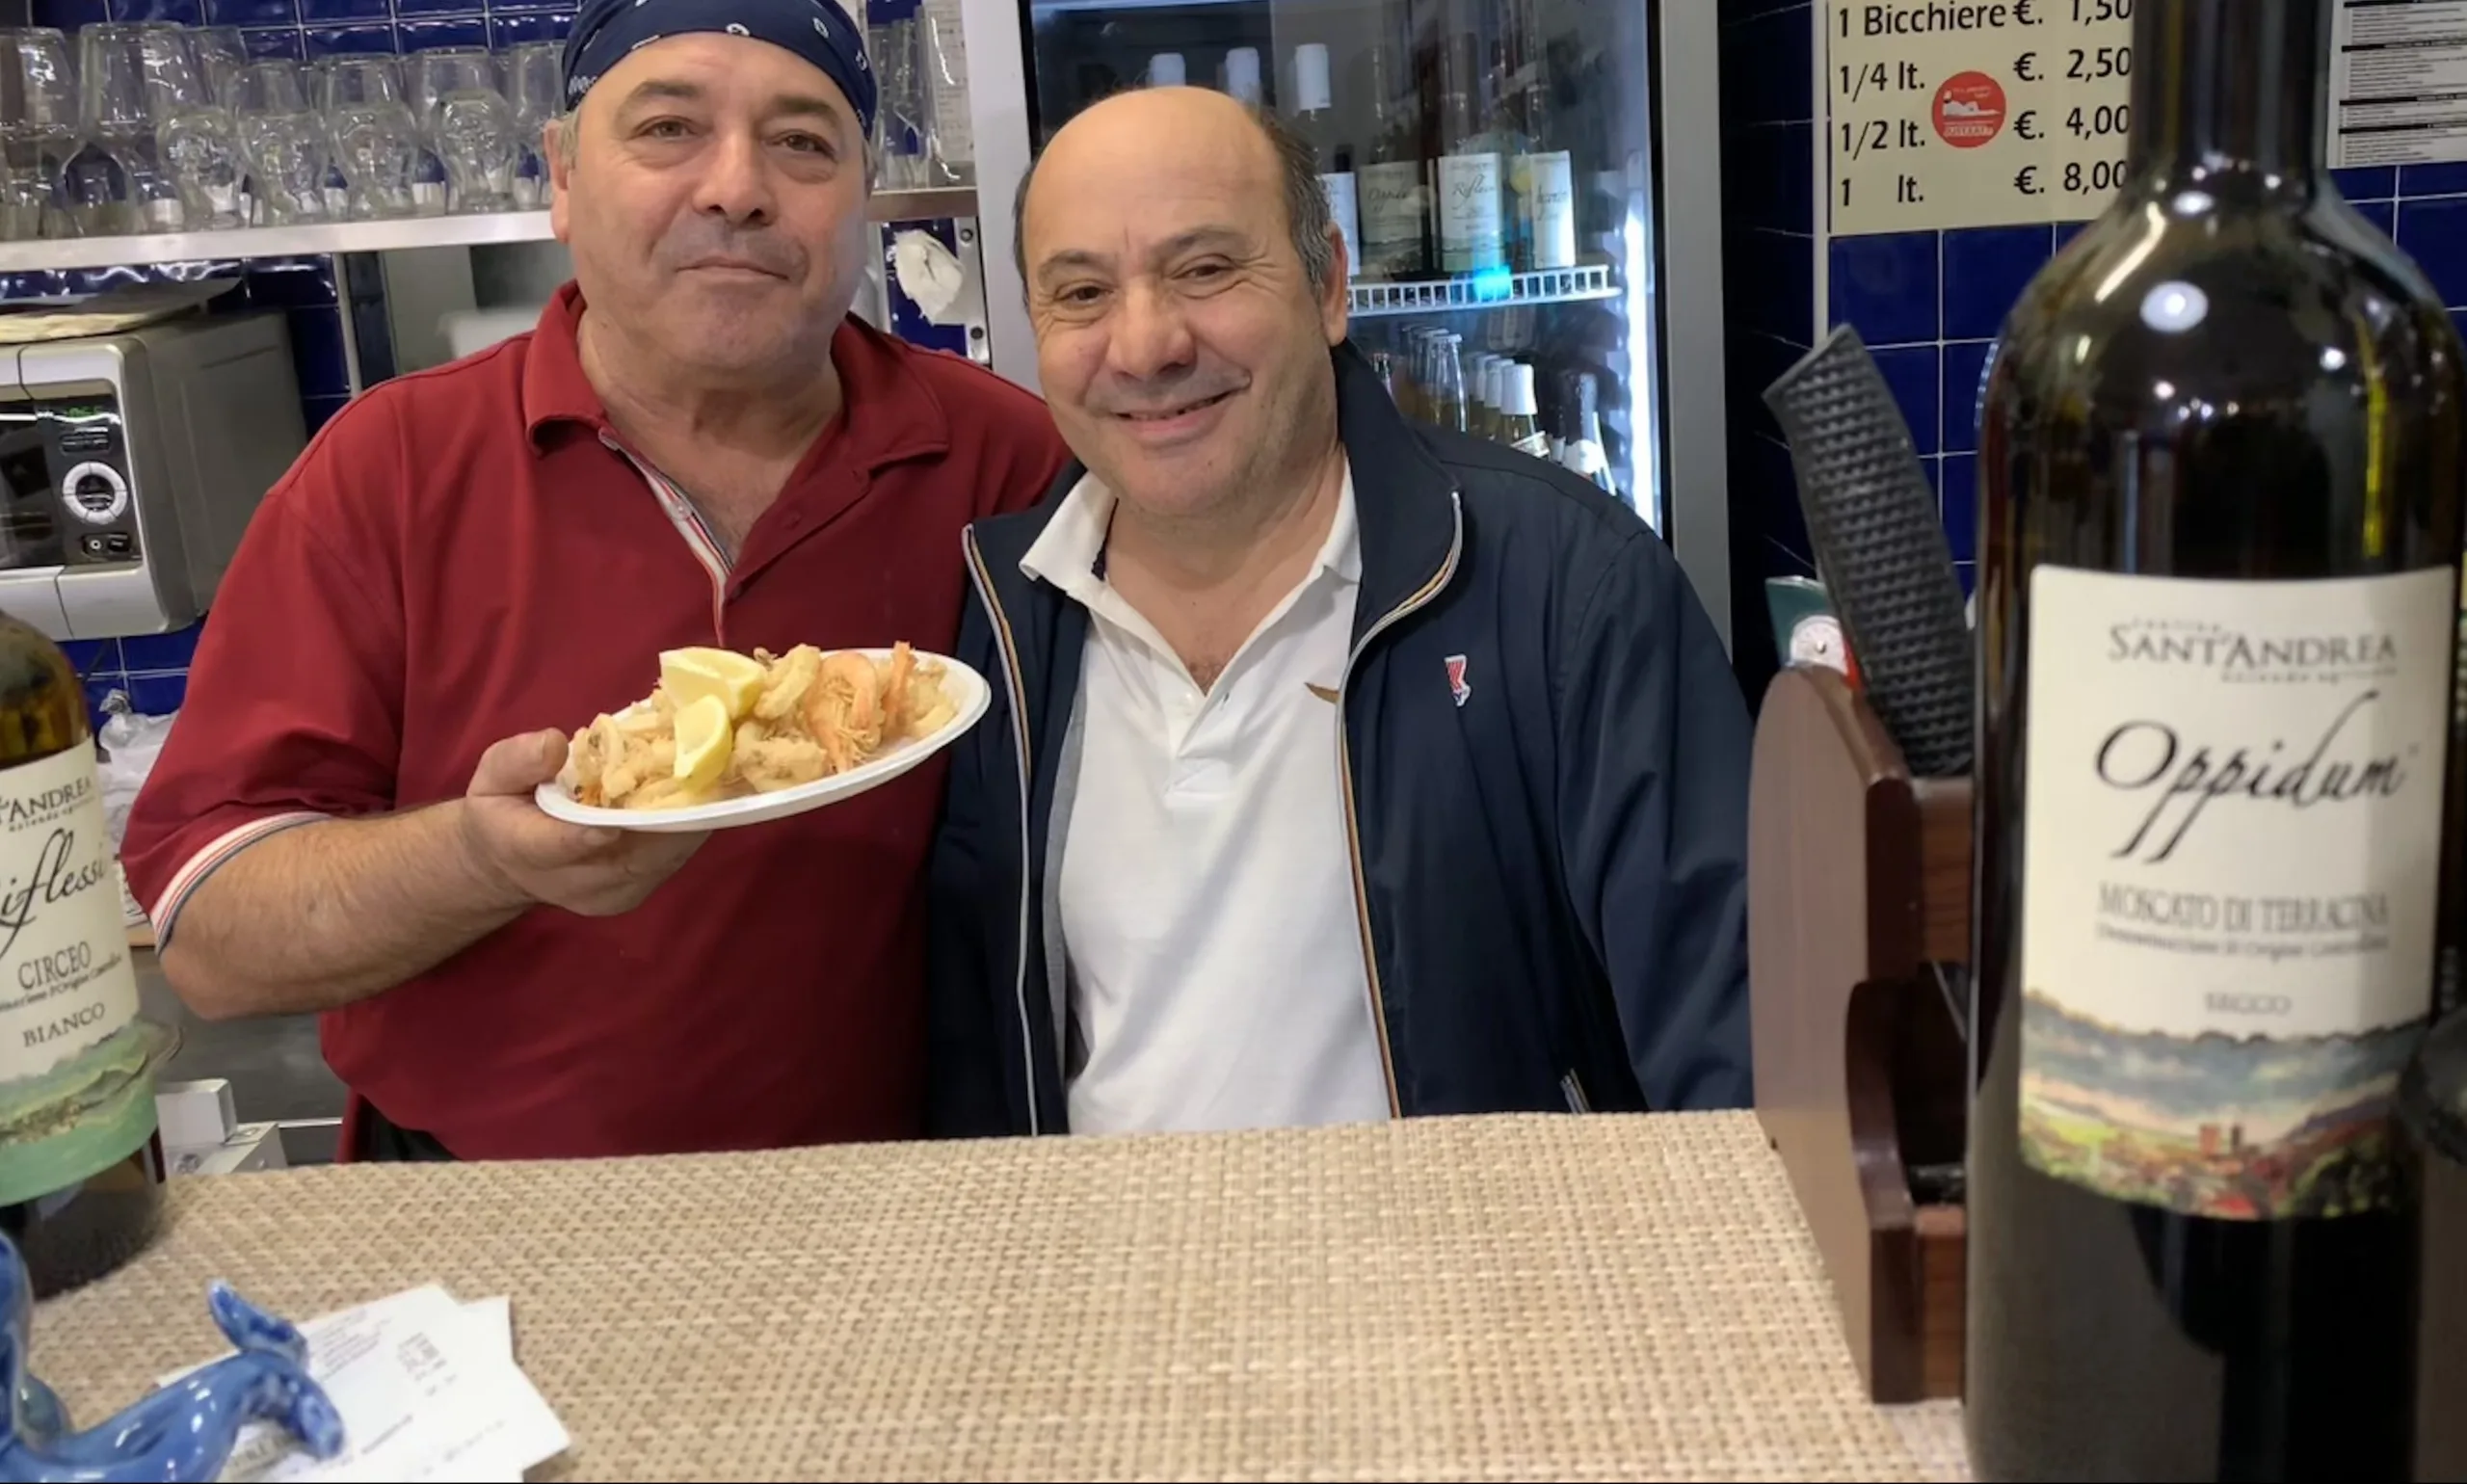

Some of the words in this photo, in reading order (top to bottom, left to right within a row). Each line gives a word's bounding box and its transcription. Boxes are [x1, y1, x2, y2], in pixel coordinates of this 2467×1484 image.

[1840, 8, 1849, 38] 1
[1864, 1, 2006, 36] Bicchiere
[2071, 0, 2132, 26] 1,50
[1840, 63, 1888, 103] 1/4
[1898, 61, 1925, 91] lt.
[2013, 52, 2044, 82] €.
[2066, 47, 2132, 83] 2,50
[1842, 120, 1889, 161] 1/2
[1899, 119, 1925, 147] lt.
[2013, 111, 2045, 140] €.
[2066, 105, 2131, 140] 4,00
[1842, 178, 1851, 206] 1
[1897, 174, 1924, 203] lt.
[2014, 165, 2045, 195] €.
[2063, 160, 2128, 195] 8,00
[2108, 624, 2398, 669] SANT'ANDREA
[2094, 690, 2405, 865] Oppidum
[2097, 880, 2216, 930] MOSCATO
[2223, 896, 2252, 932] DI
[17, 941, 92, 991] CIRCEO
[22, 1002, 105, 1048] BIANCO
